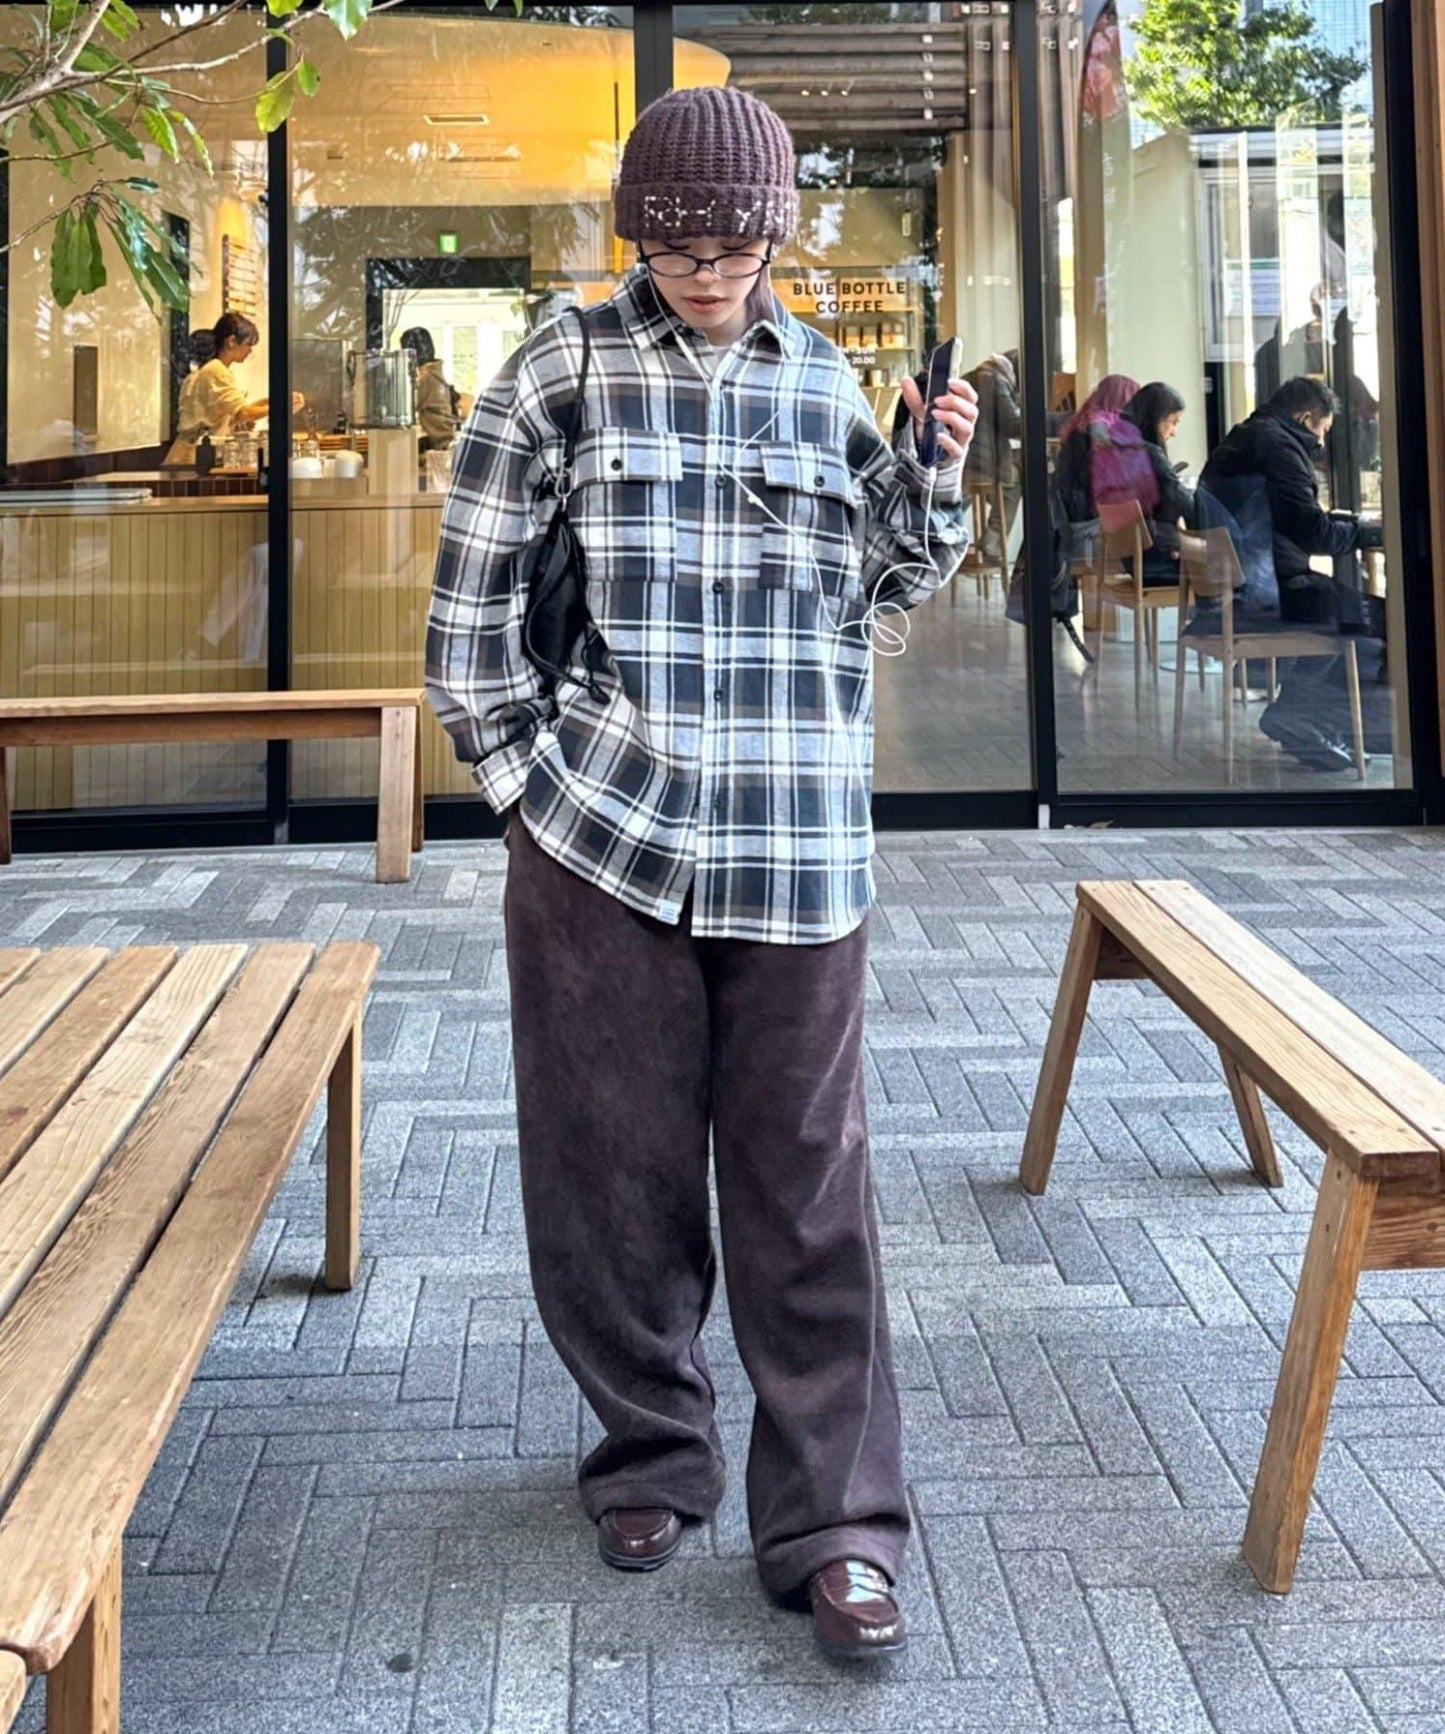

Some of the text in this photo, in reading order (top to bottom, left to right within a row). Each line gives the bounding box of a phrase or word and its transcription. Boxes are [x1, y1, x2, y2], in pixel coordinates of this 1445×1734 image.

[793, 282, 907, 296] BLUE BOTTLE
[815, 300, 884, 314] COFFEE
